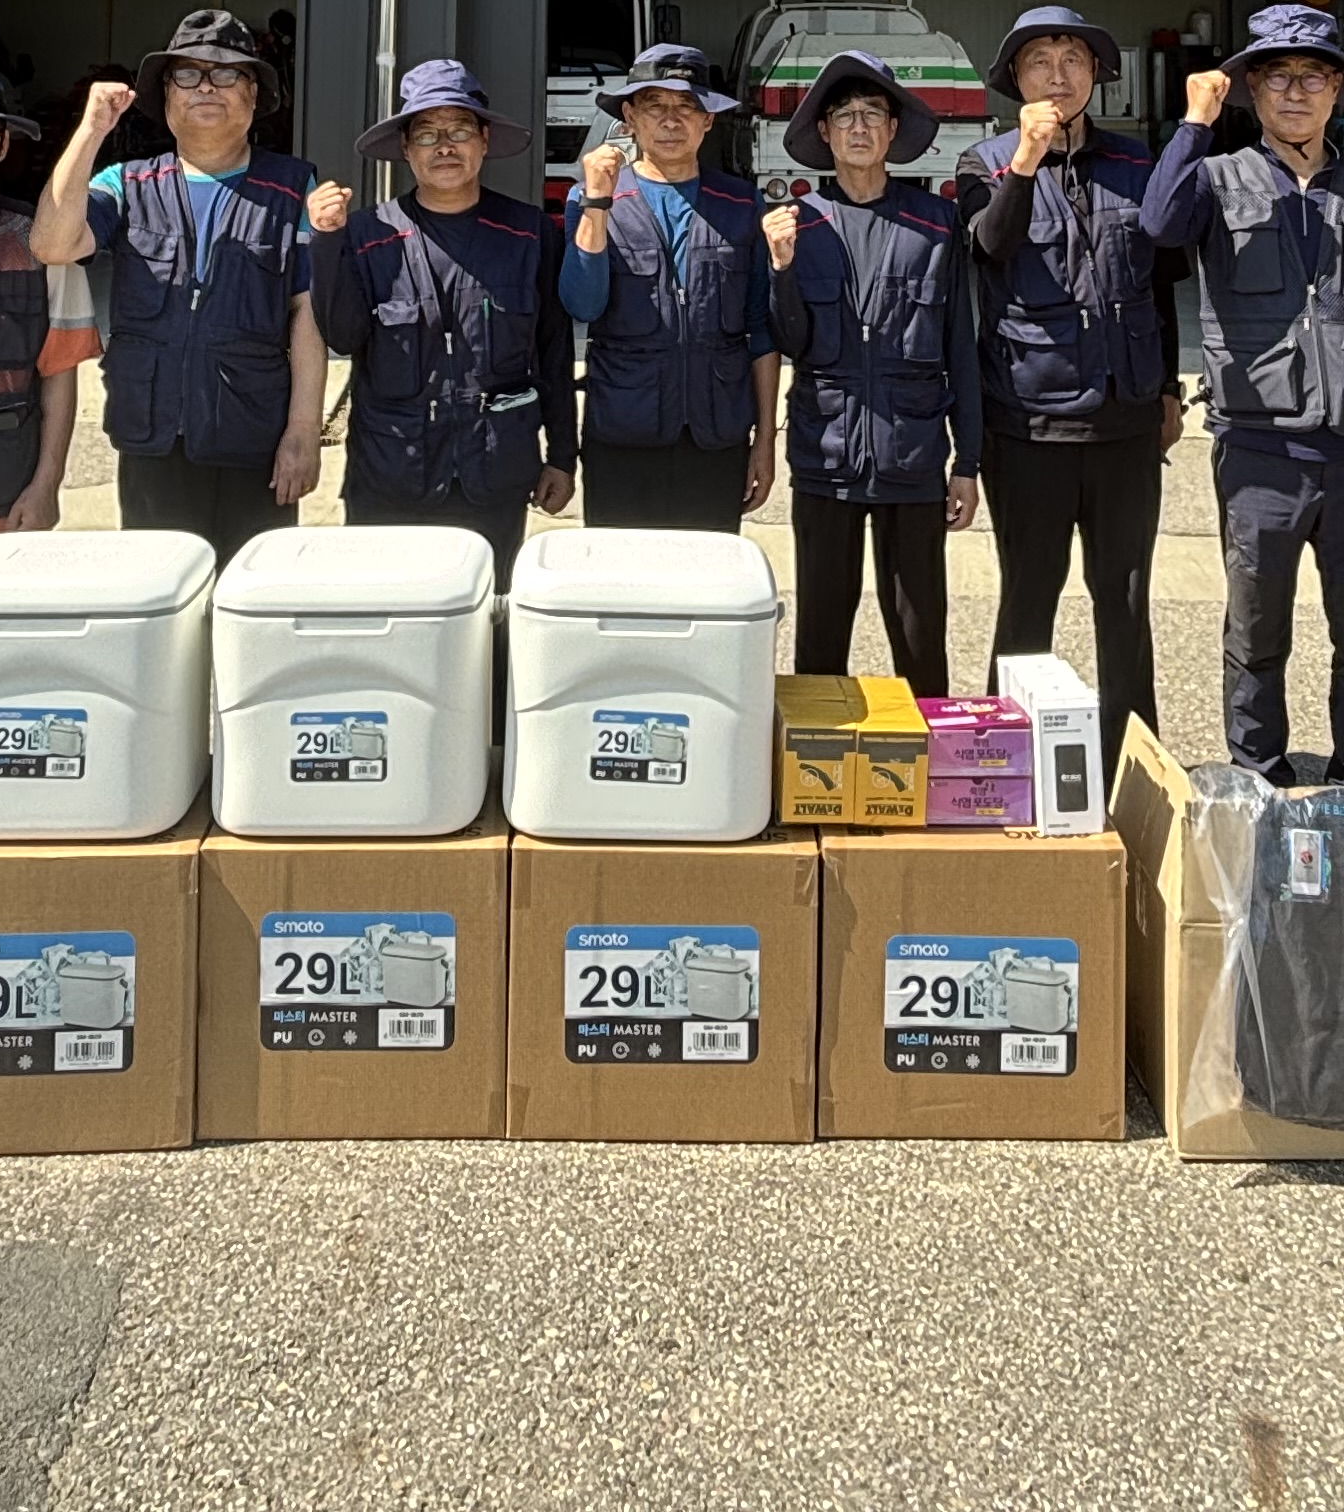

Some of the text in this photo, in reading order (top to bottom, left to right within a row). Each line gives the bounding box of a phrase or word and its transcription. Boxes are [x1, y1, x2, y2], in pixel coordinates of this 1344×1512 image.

[296, 731, 341, 755] 29L
[597, 729, 642, 755] 29L
[273, 920, 324, 934] smato
[578, 933, 628, 947] smato
[899, 943, 950, 957] smato
[274, 952, 361, 995] 29L
[579, 964, 666, 1008] 29L
[899, 975, 984, 1019] 29L
[273, 1010, 358, 1024] 마스터 MASTER
[577, 1023, 662, 1037] 마스터 MASTER
[273, 1031, 293, 1044] PU
[896, 1033, 981, 1047] 마스터 MASTER
[577, 1044, 597, 1057] PU
[896, 1053, 916, 1066] PU
